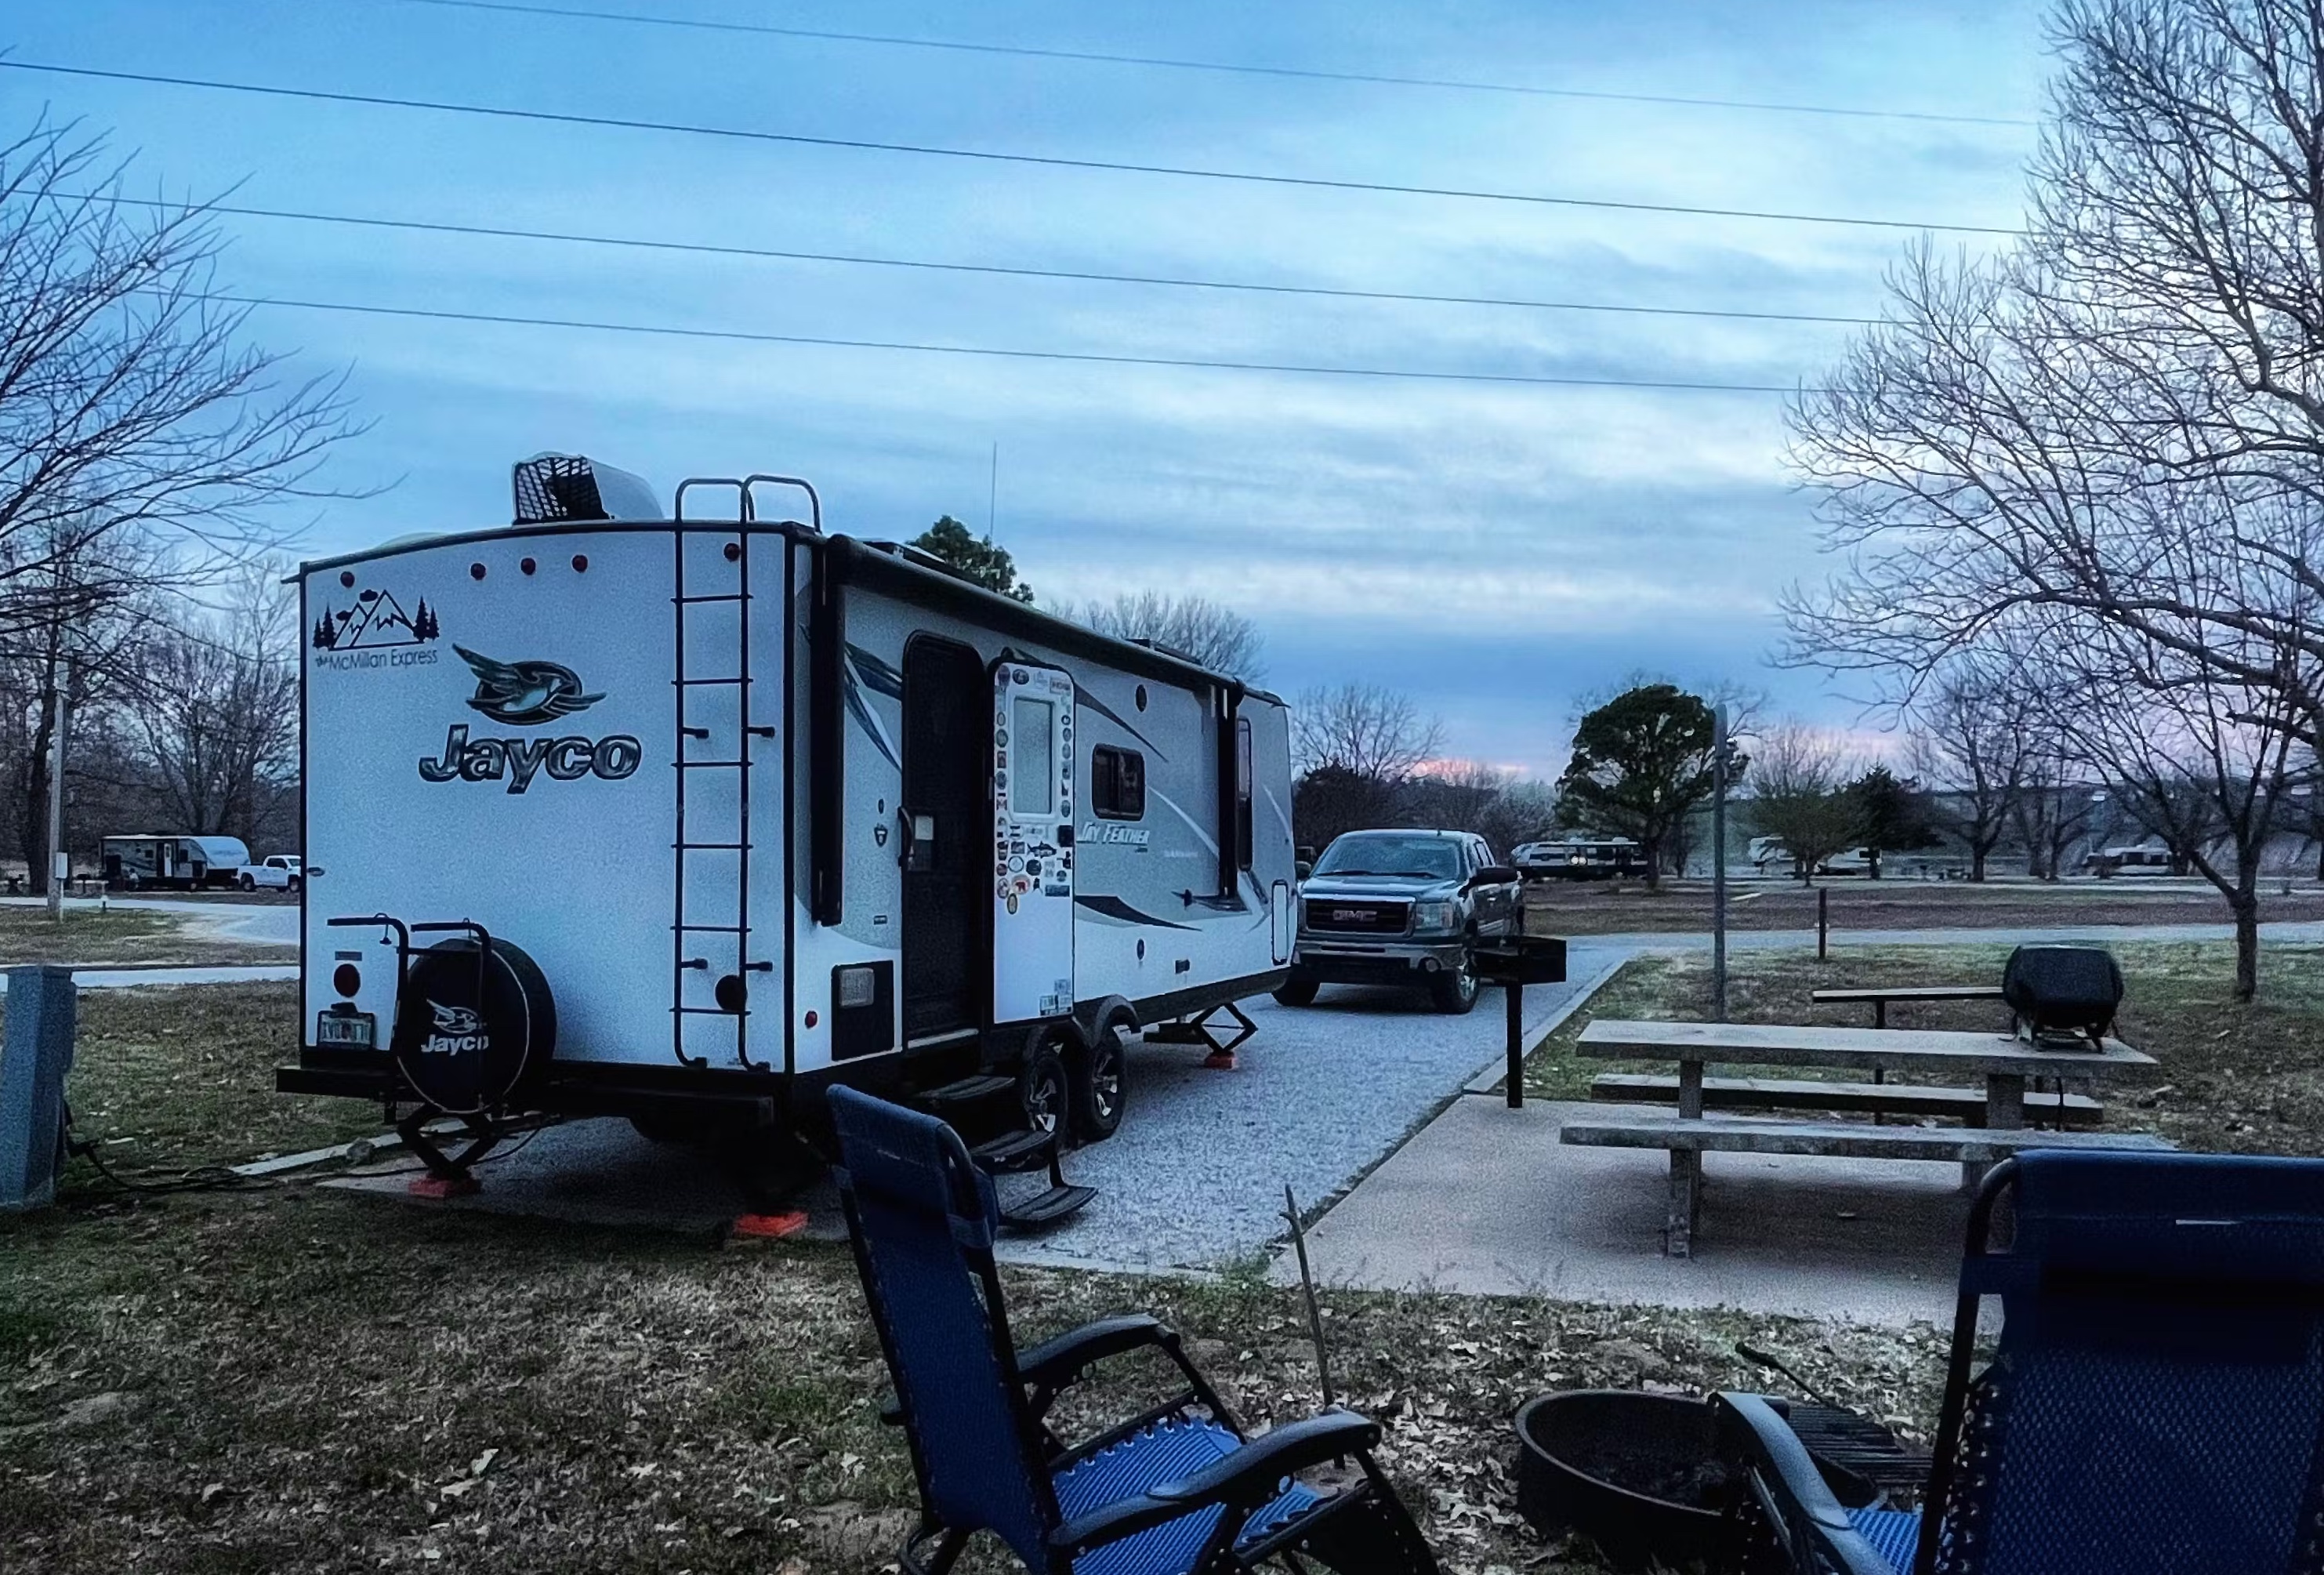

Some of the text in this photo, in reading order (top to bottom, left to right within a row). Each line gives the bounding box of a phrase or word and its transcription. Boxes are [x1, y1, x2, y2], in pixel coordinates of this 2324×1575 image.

[329, 651, 387, 670] McMillan
[391, 648, 438, 669] Express
[419, 724, 642, 795] Jayco
[1332, 909, 1378, 922] GMC
[421, 1033, 489, 1057] Jayco
